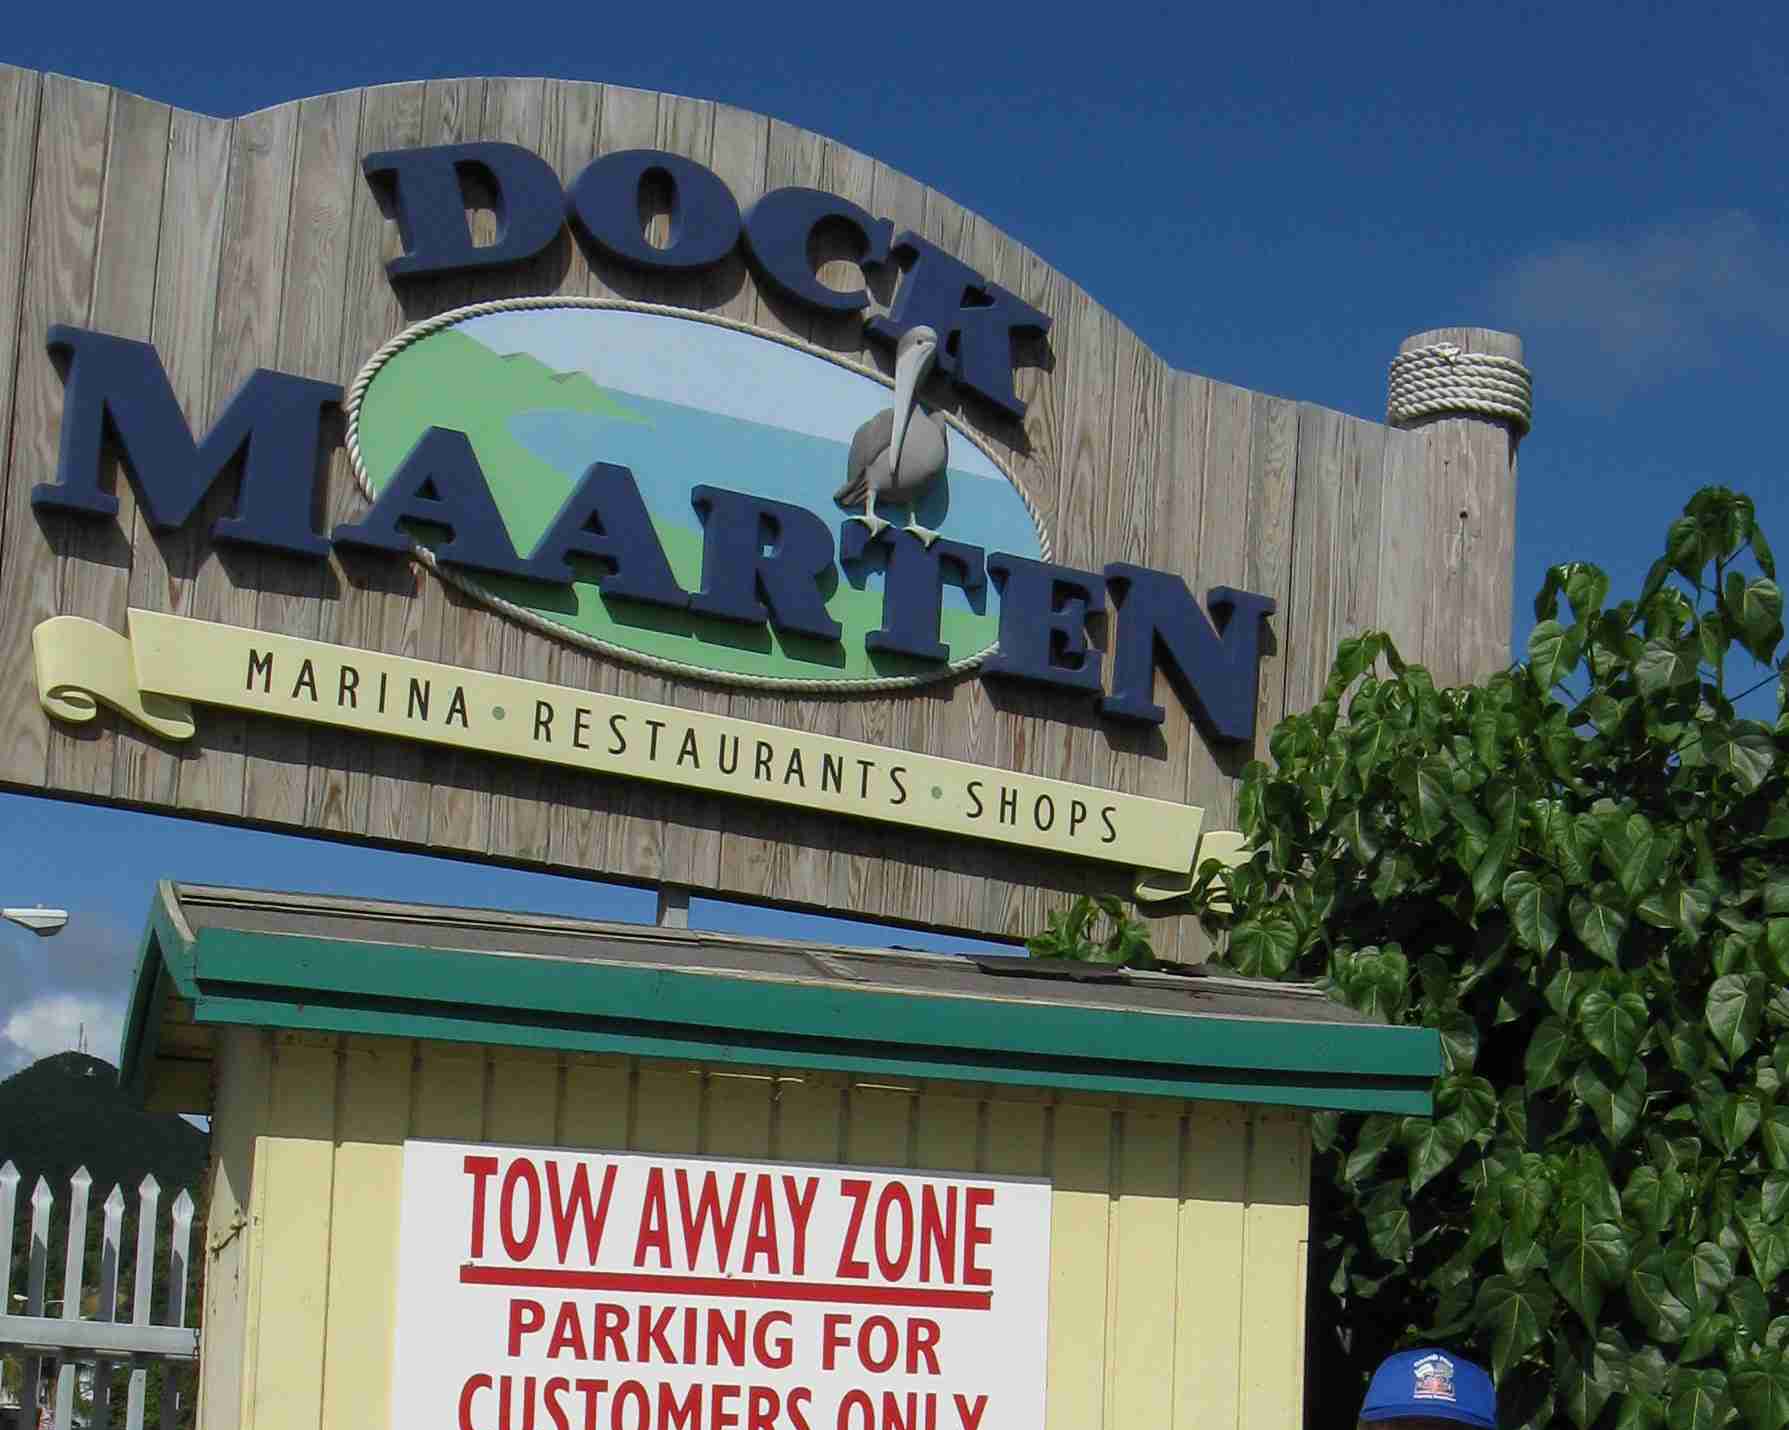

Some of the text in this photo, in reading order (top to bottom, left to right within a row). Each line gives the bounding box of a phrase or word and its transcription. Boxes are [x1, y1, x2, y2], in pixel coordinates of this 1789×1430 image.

[363, 141, 1052, 418] DOCK
[32, 323, 1275, 742] MAARTEN
[245, 649, 1118, 845] MARINA RESTAURANTS SHOPS
[463, 1156, 994, 1286] TOW AWAY ZONE
[507, 1299, 941, 1375] PARKING FOR
